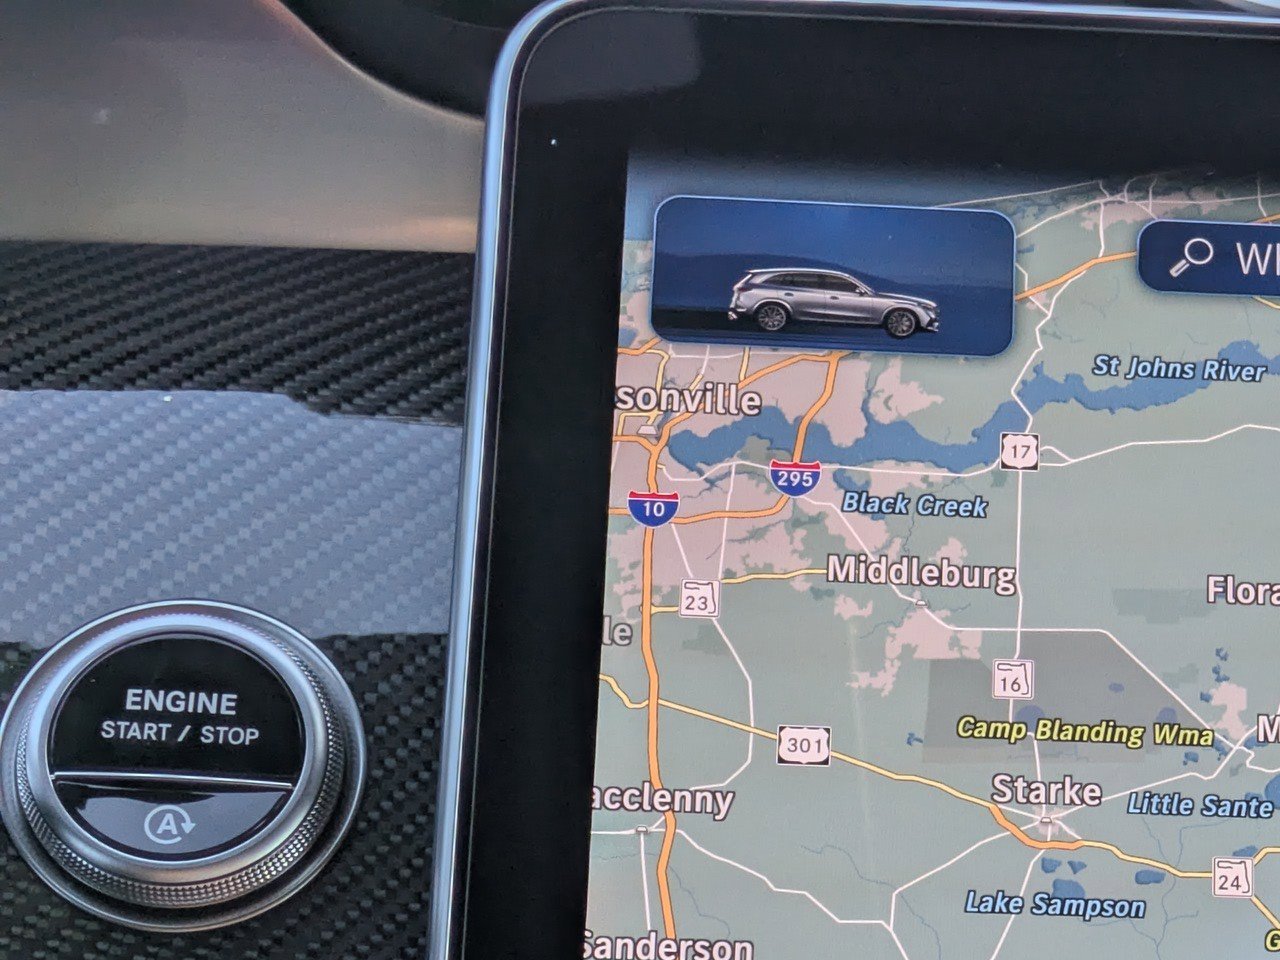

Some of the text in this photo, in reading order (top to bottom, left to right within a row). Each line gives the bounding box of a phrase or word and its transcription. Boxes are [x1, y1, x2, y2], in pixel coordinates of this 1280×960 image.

[1092, 355, 1267, 383] St Johns River
[615, 383, 762, 417] sonville
[1011, 444, 1031, 460] 17
[778, 471, 813, 488] 295
[643, 501, 665, 517] 10
[843, 492, 988, 518] Black Creek
[827, 555, 1017, 596] Middleburg
[684, 594, 709, 611] 23
[1000, 677, 1022, 692] 16
[125, 688, 237, 715] ENGINE
[101, 721, 172, 742] START
[200, 726, 259, 746] STOP
[957, 717, 1215, 748] Camp Blanding Wma
[787, 738, 823, 754] 301
[991, 774, 1102, 806] Starke
[1128, 793, 1194, 818] Little
[1201, 795, 1274, 819] Sante
[1218, 875, 1242, 891] 24
[964, 892, 1146, 920] Lake Sampson
